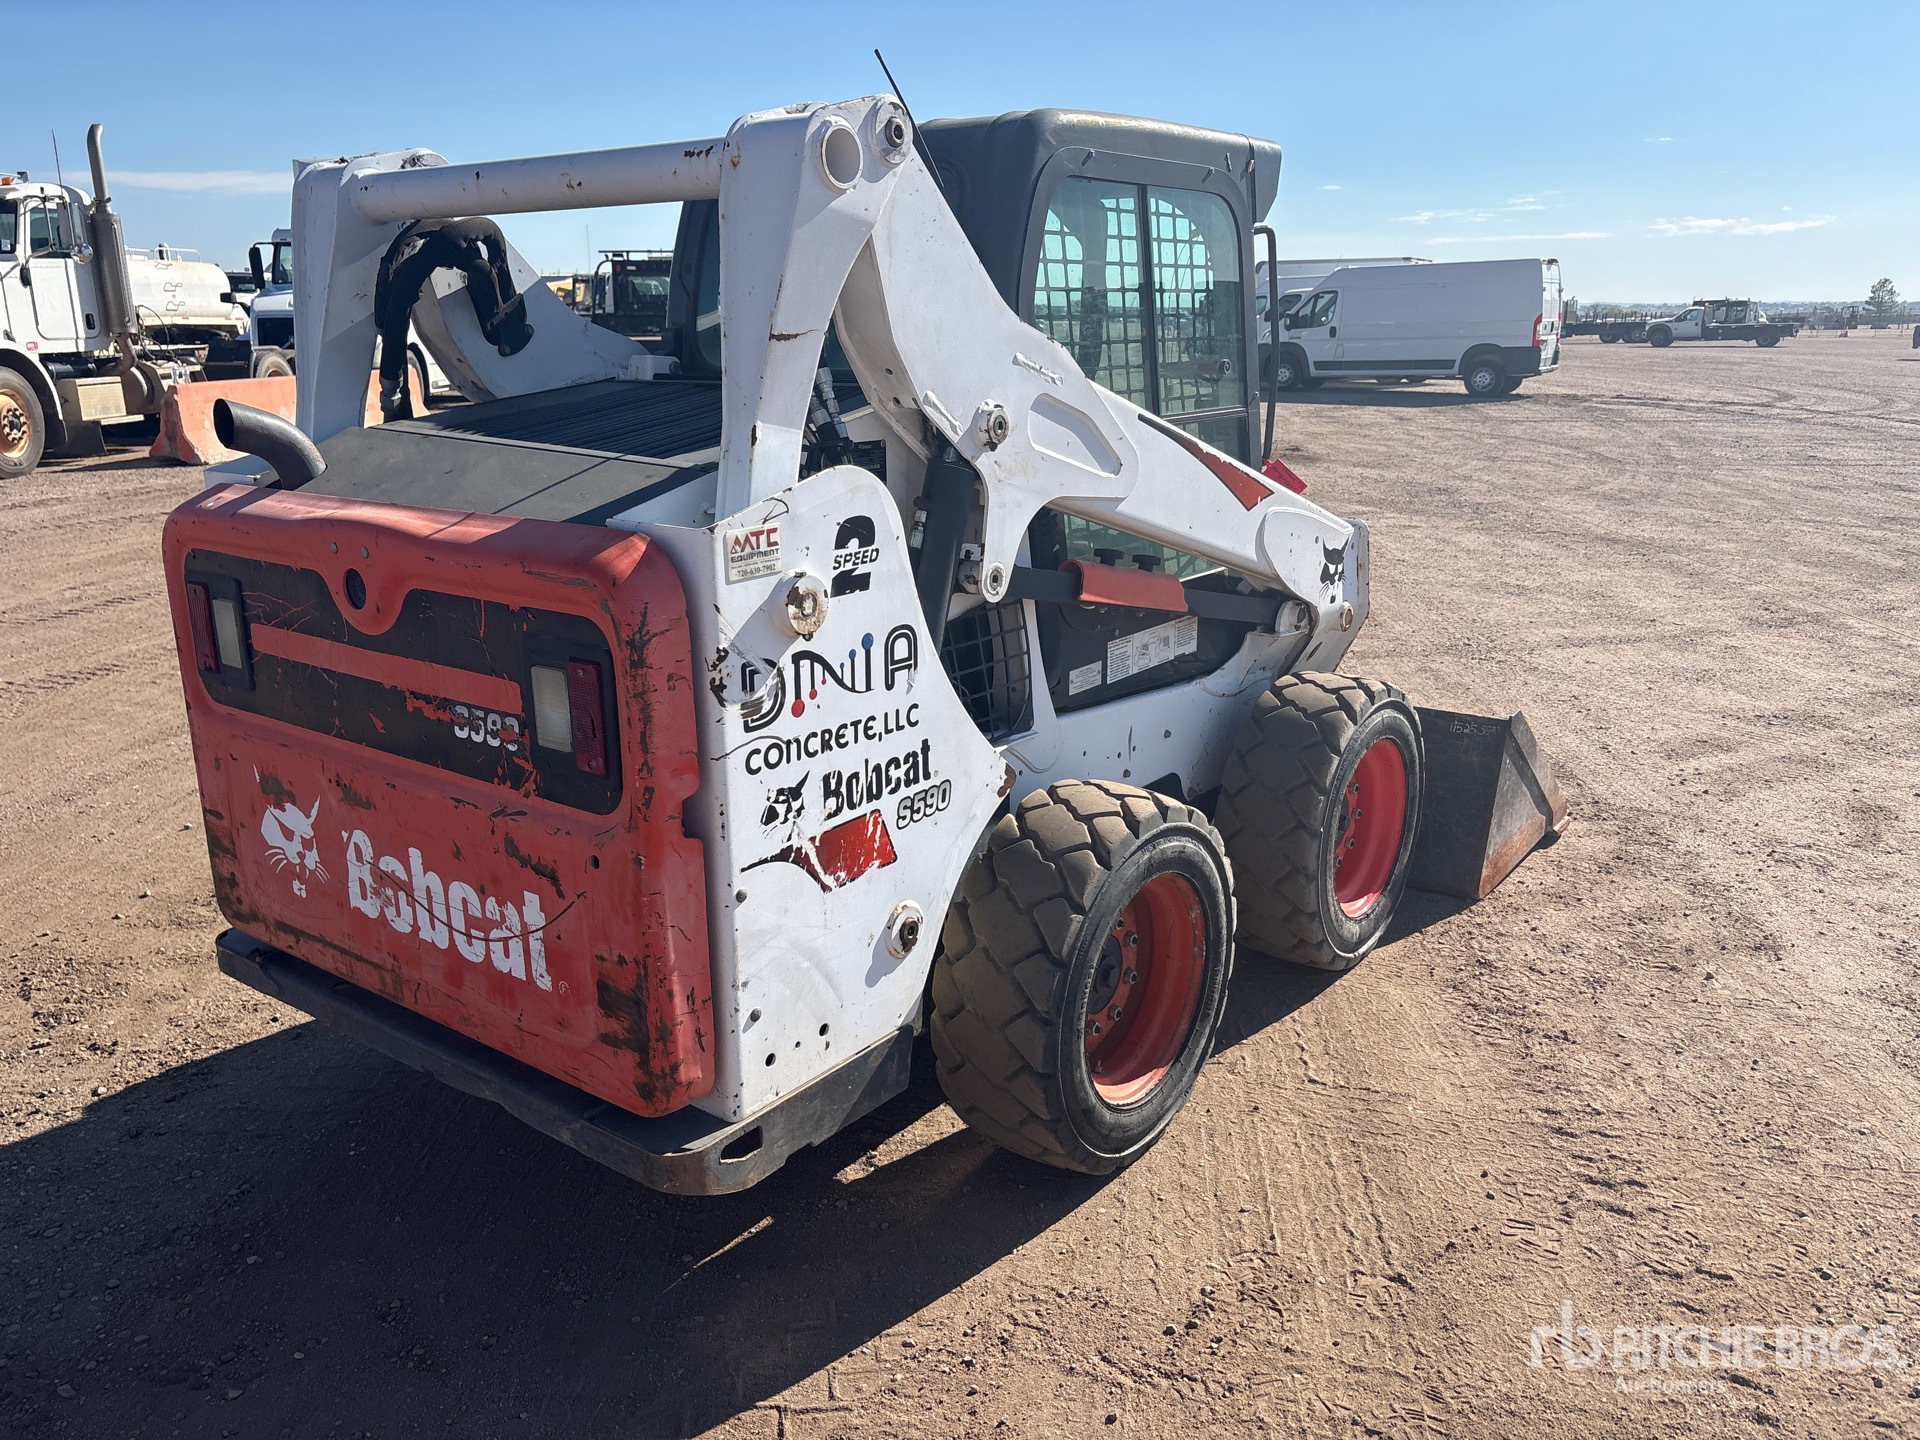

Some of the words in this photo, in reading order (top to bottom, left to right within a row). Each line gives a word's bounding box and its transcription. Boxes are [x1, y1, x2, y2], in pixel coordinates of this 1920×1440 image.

[731, 548, 780, 563] EQUIPMENT
[737, 569, 776, 582] 720-630-7902
[830, 515, 876, 598] 2
[833, 547, 880, 570] SPEED
[823, 738, 932, 821] Bobcat
[896, 779, 952, 830] S590
[342, 829, 552, 992] Bobcat
